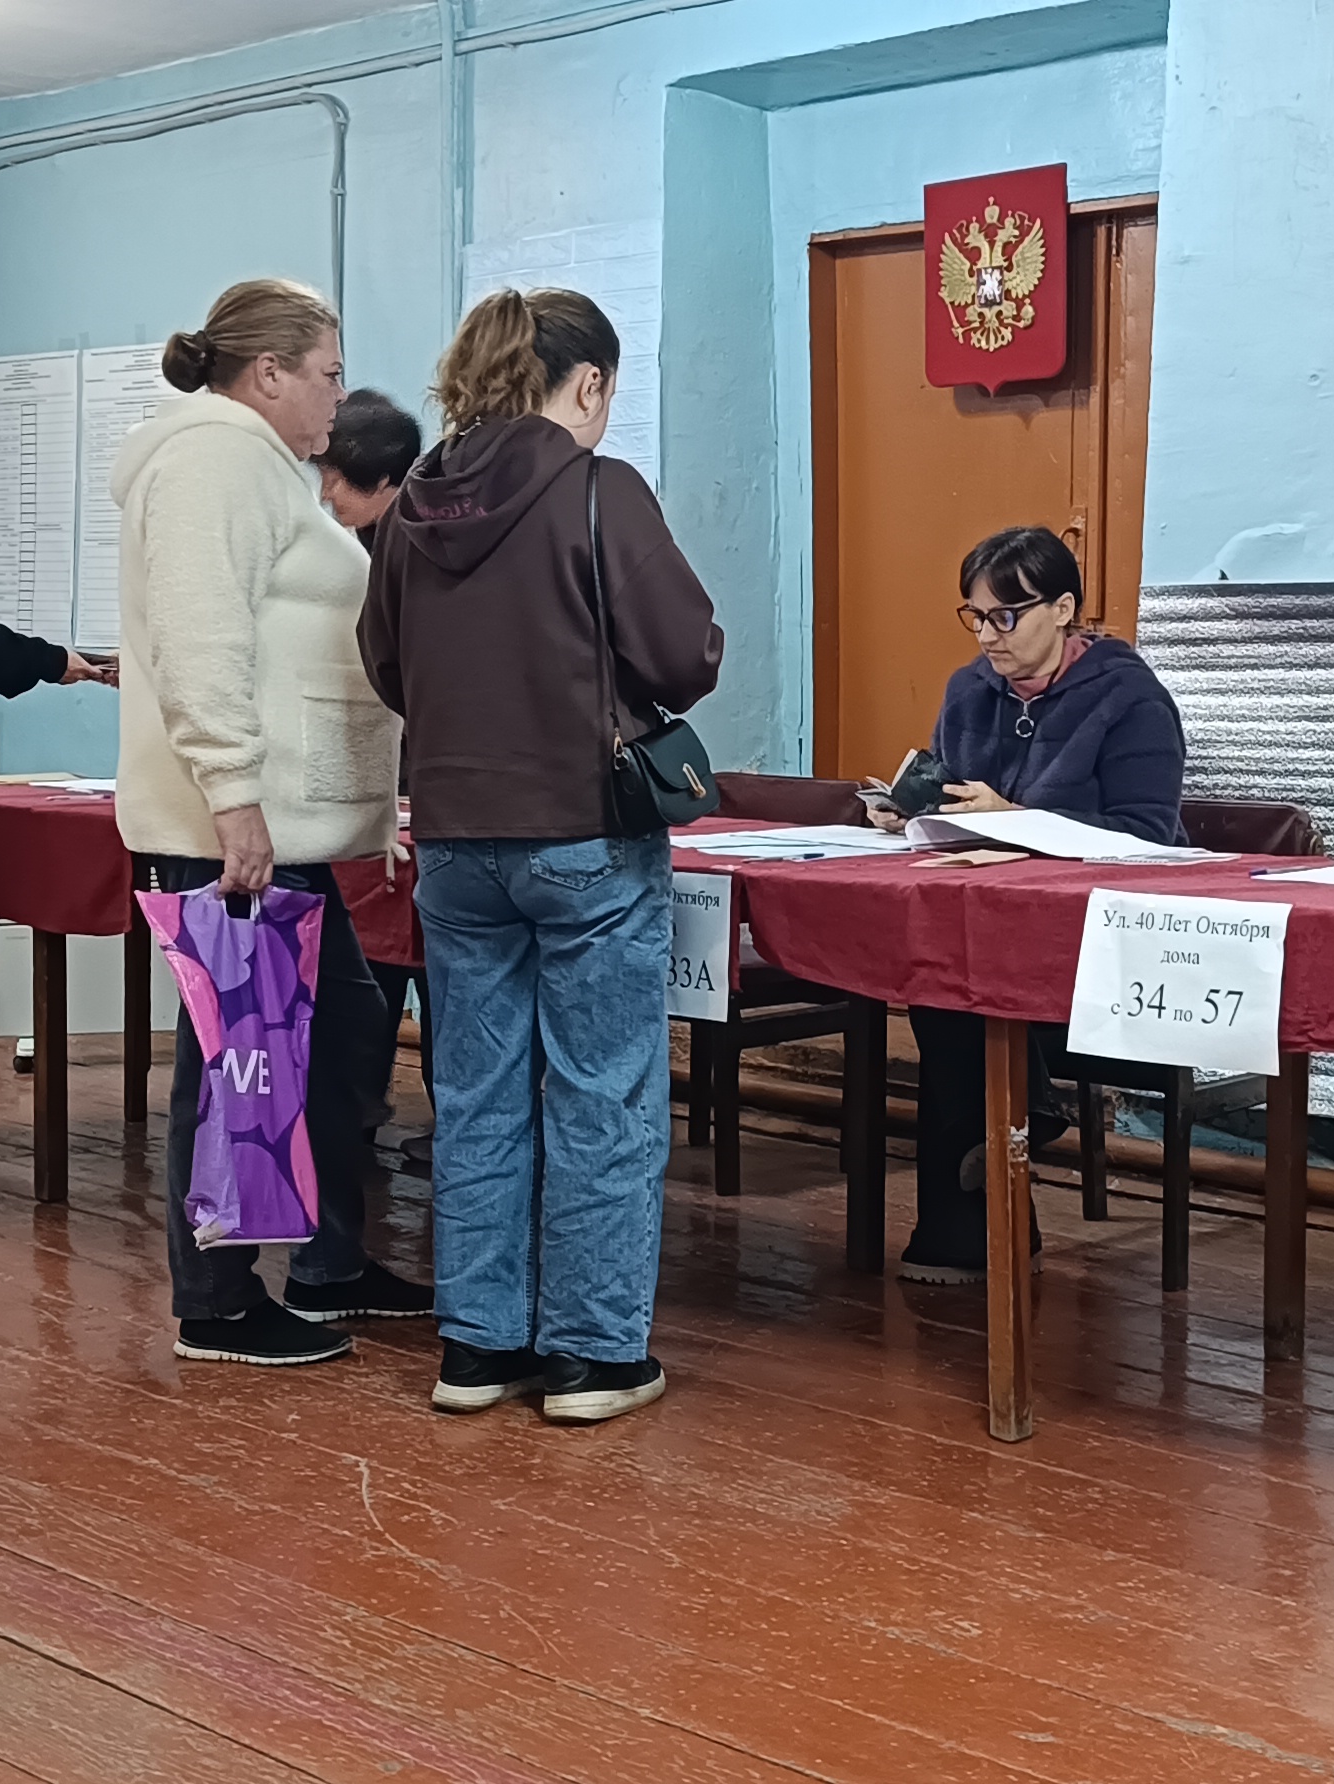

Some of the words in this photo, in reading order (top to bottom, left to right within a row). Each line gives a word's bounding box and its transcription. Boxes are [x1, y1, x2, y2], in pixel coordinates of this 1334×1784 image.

[671, 887, 720, 910] ктября
[1103, 909, 1130, 929] Ул.
[1134, 911, 1155, 931] 40
[1158, 913, 1192, 933] Лет
[1196, 915, 1271, 942] Октября
[1160, 949, 1200, 965] дома
[1110, 1002, 1121, 1015] с
[1127, 981, 1167, 1020] 34
[1173, 1008, 1193, 1022] по
[1200, 988, 1244, 1027] 57
